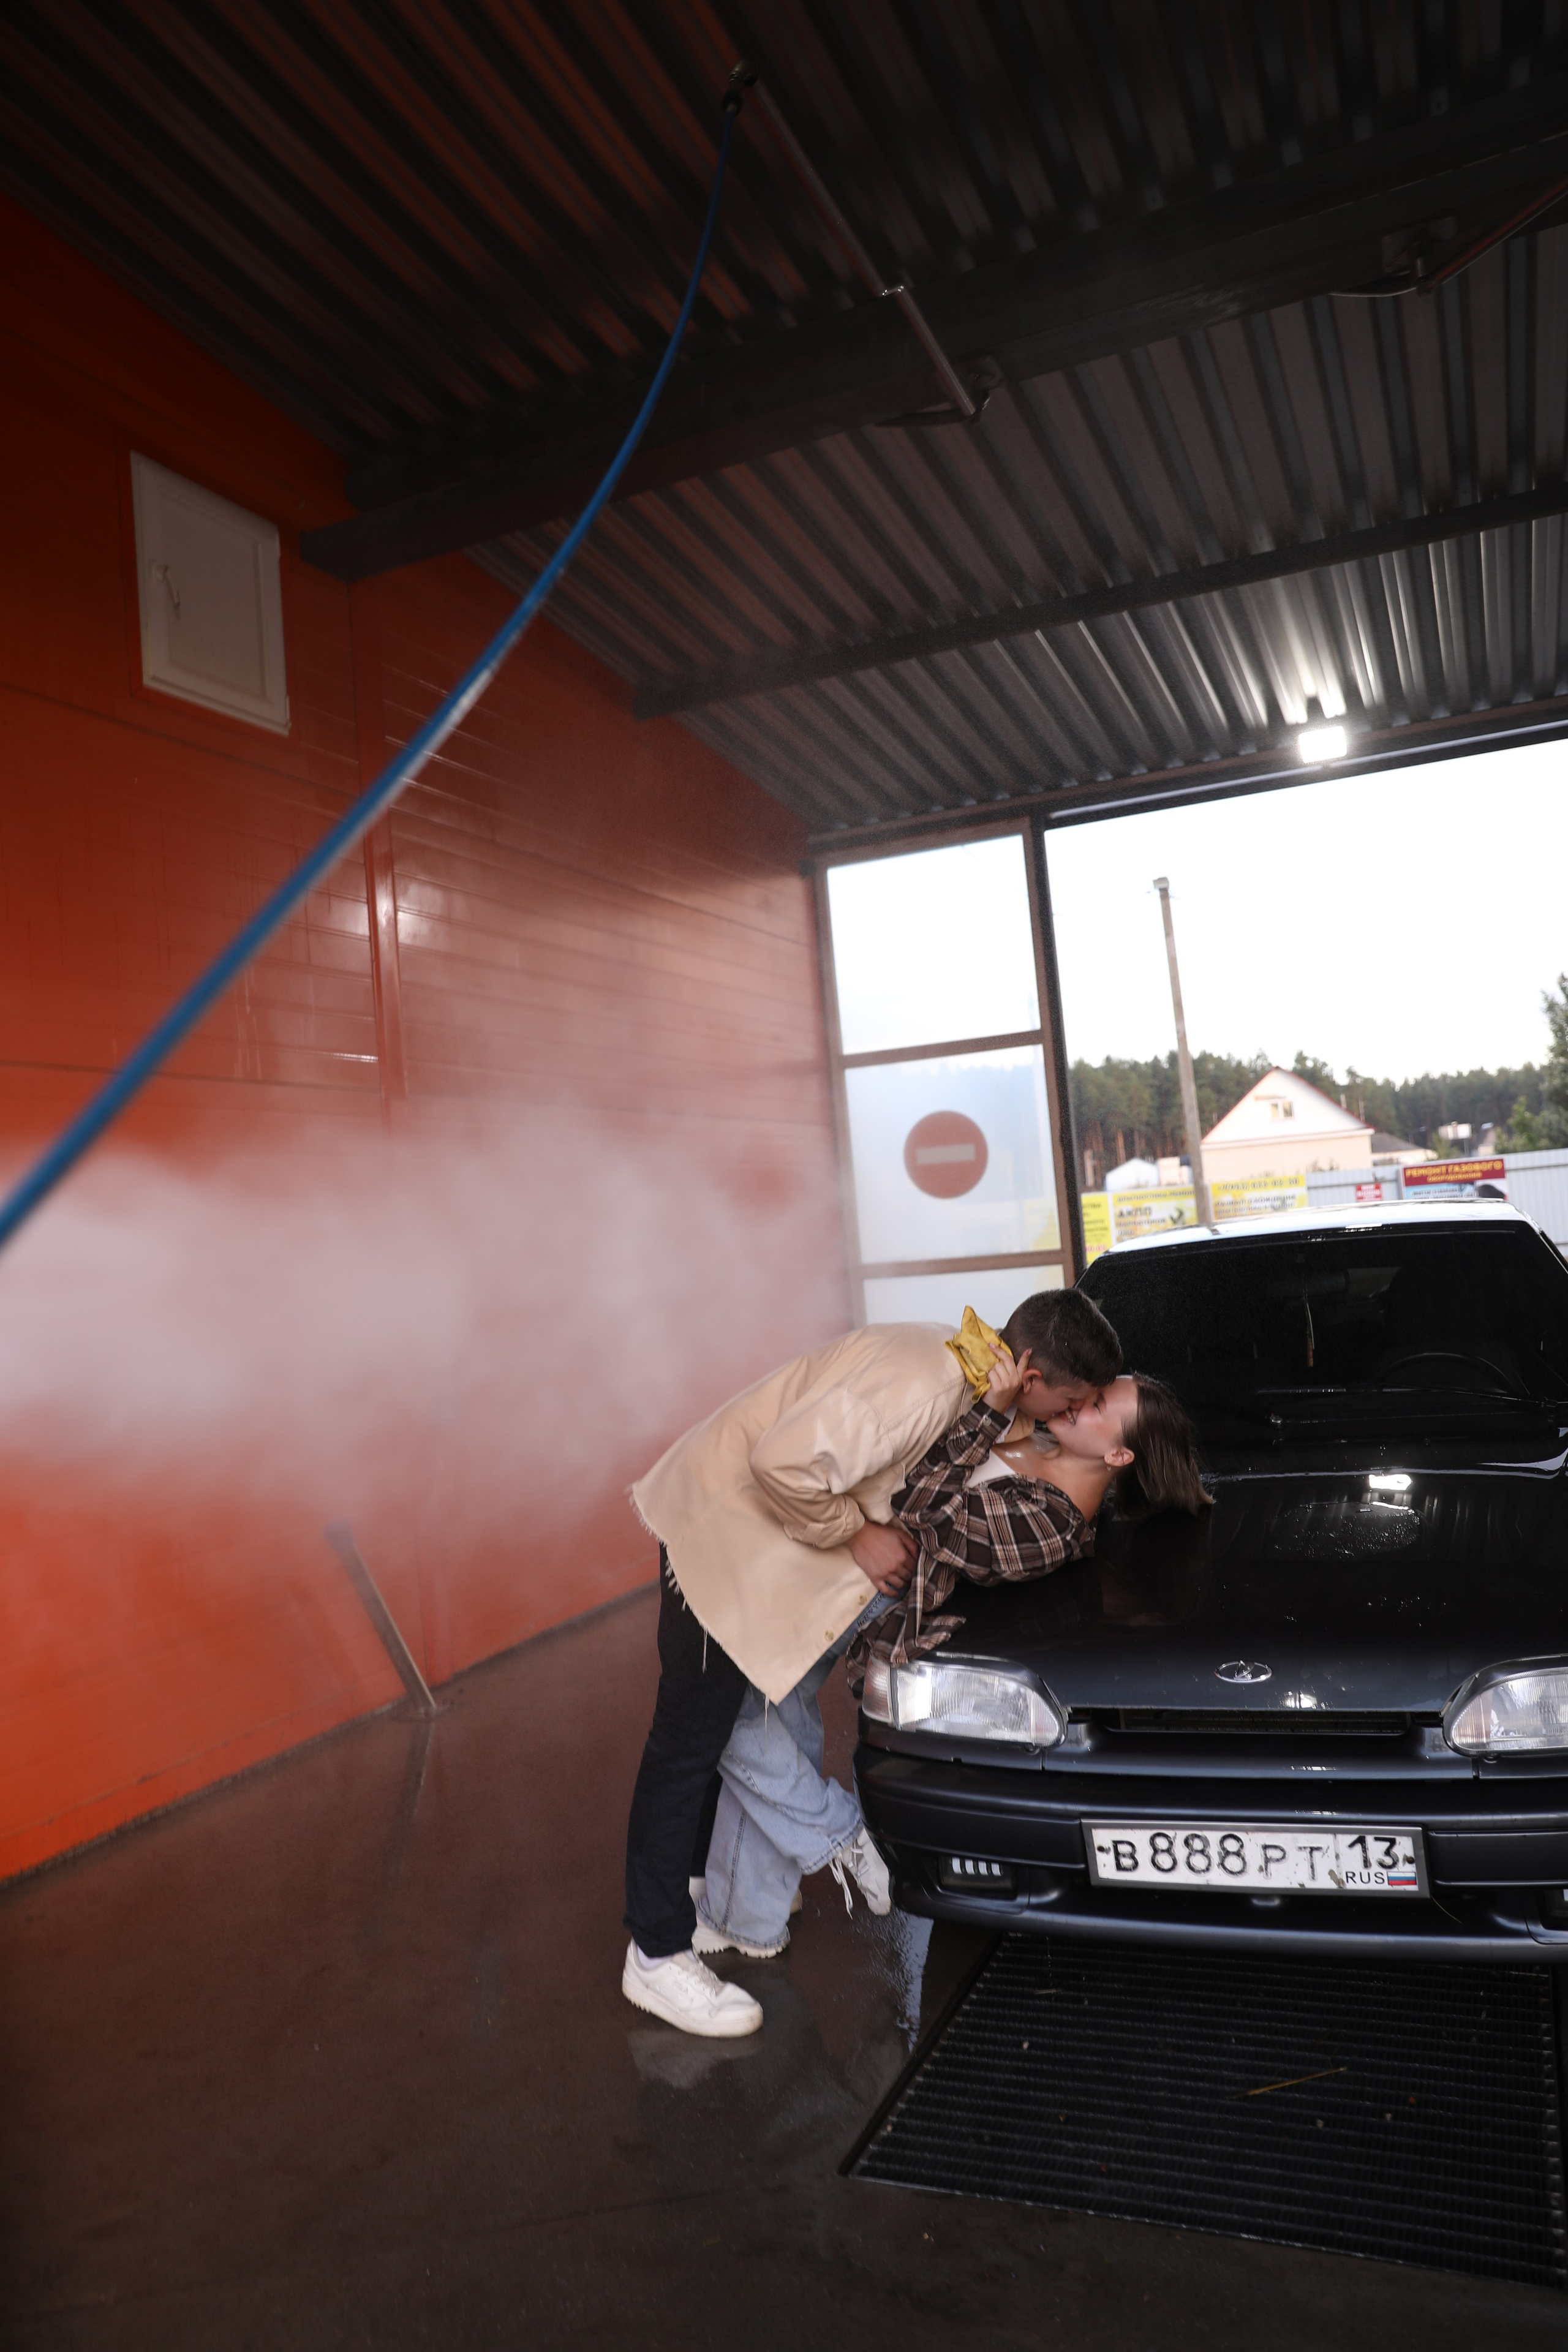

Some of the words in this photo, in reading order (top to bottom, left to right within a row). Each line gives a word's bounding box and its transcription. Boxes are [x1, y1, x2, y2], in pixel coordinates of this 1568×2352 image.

[1406, 1166, 1446, 1177] РЕМОНТ
[1449, 1161, 1502, 1172] ГАЗОВОГО
[1427, 1172, 1482, 1182] ОБОРУДОВАНИЯ
[1348, 1834, 1400, 1869] 13
[1346, 1871, 1385, 1885] RUS
